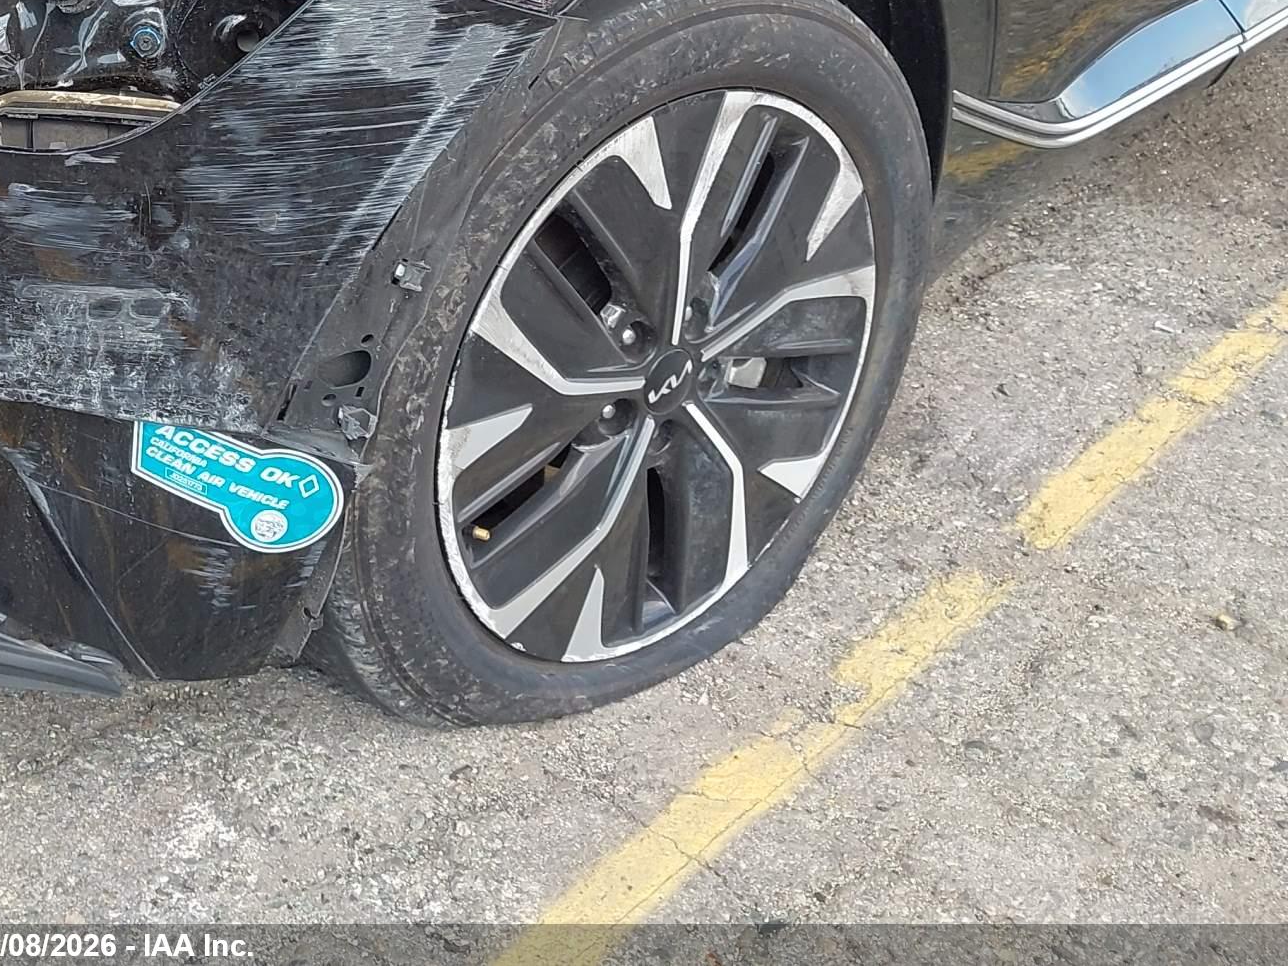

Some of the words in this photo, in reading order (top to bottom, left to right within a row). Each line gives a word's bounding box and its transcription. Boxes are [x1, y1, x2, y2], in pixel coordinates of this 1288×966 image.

[145, 446, 194, 476] CLEAN
[197, 471, 226, 489] AIR
[228, 482, 291, 510] VEHICLE
[150, 437, 208, 468] CALIFORNIA
[155, 425, 257, 473] ACCESS
[260, 466, 301, 489] OK
